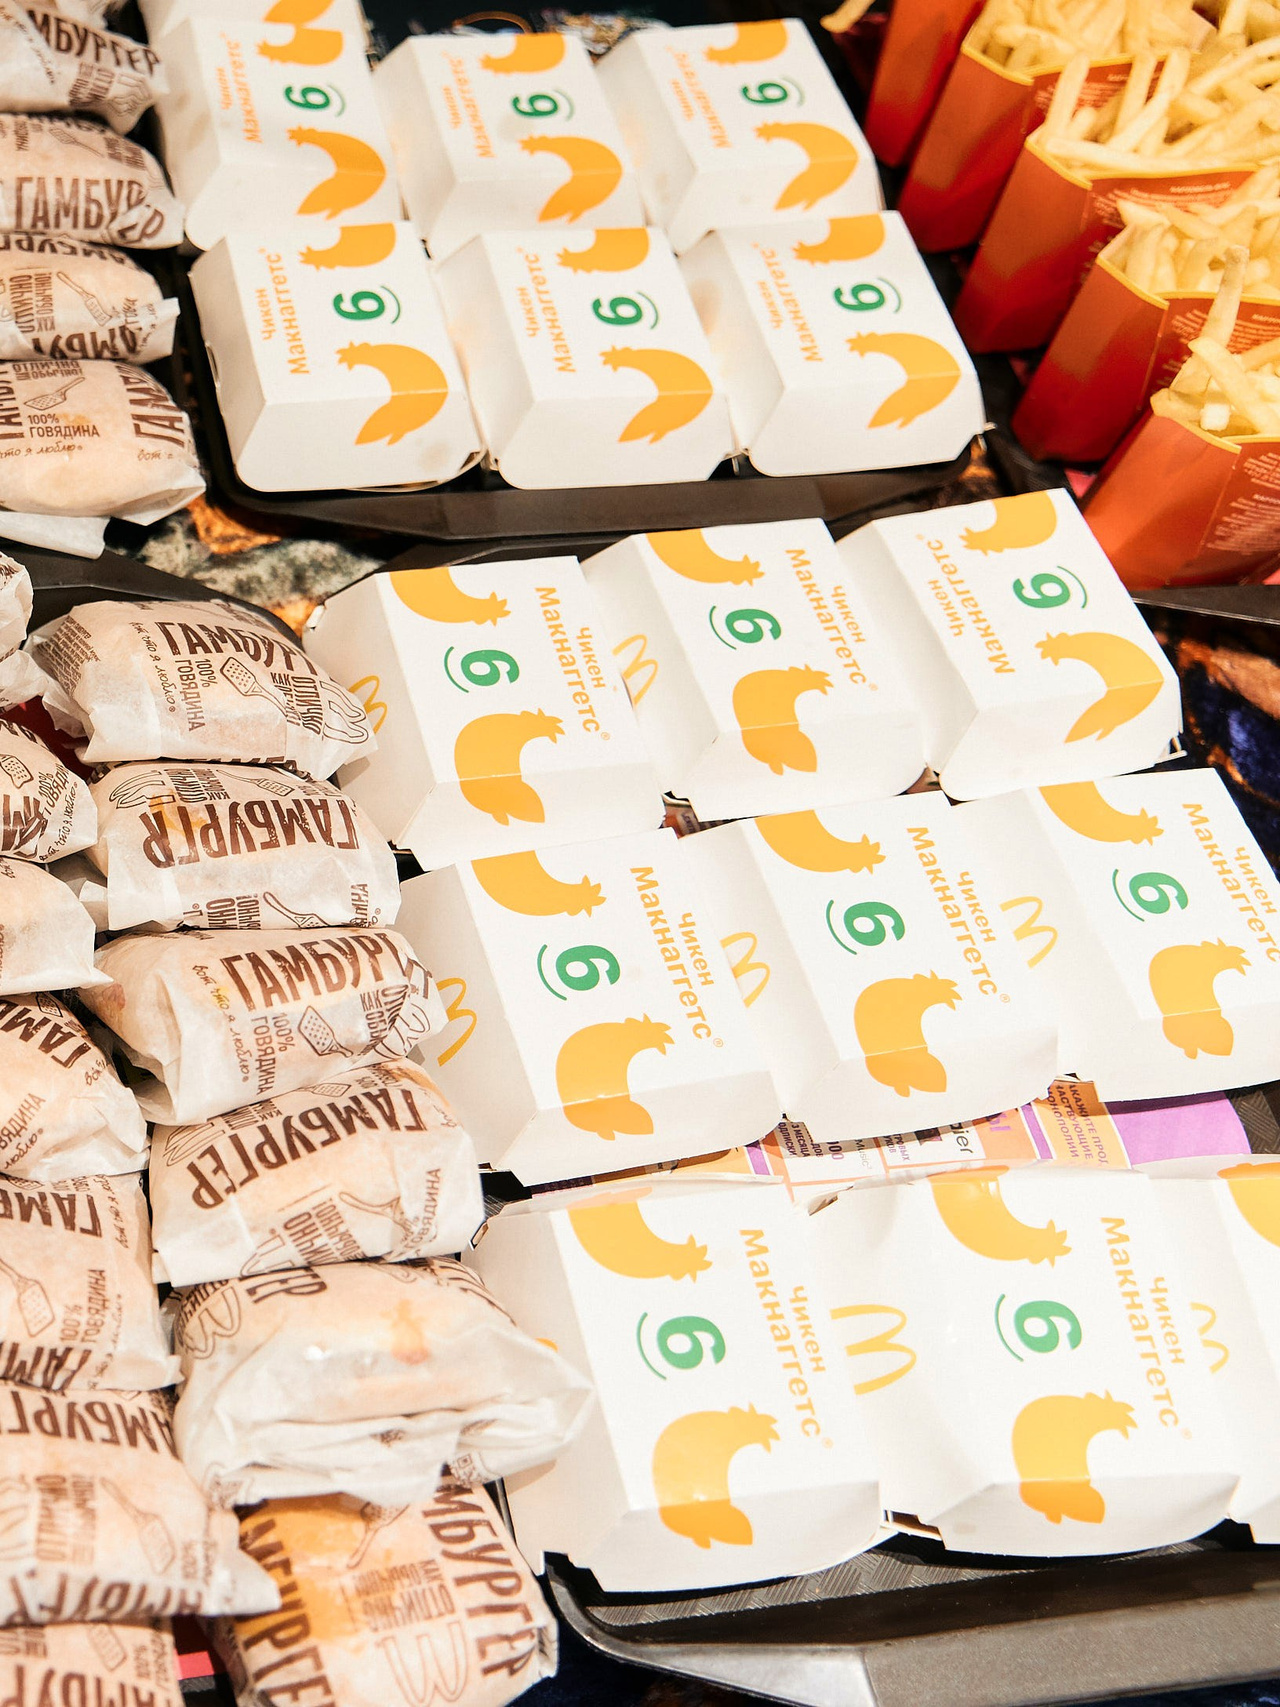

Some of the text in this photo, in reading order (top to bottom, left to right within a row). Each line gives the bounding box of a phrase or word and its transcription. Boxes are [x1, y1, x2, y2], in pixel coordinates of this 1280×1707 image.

[284, 85, 331, 110] 6
[511, 93, 559, 118] 6
[741, 82, 789, 105] 6
[255, 288, 272, 341] Чикен
[333, 290, 386, 321] 6
[519, 286, 539, 338] Чикен
[591, 295, 644, 327] 6
[757, 280, 782, 331] Чикен
[834, 283, 886, 313] 6
[27, 414, 60, 425] 100%
[29, 423, 101, 439] ГОВЯДИНА
[830, 584, 867, 644] Чикен
[927, 578, 963, 638] Чикен
[1012, 572, 1071, 609] 6
[725, 608, 782, 644] 6
[195, 658, 218, 688] 100%
[271, 672, 291, 685] КАК
[460, 648, 520, 687] 6
[575, 625, 607, 690] Чикен
[175, 659, 206, 732] ГОВЯДИНА
[1128, 872, 1189, 915] 6
[1233, 846, 1277, 915] Чикен
[843, 901, 906, 947] 6
[956, 870, 997, 943] Чикен
[555, 944, 621, 992] 6
[677, 911, 715, 987] Чикен
[360, 991, 381, 1011] КАК
[252, 1015, 277, 1095] ГОВЯДИНА
[273, 1012, 297, 1053] 100%
[186, 1085, 428, 1210] ГАМБУРГЕР
[59, 1304, 83, 1344] 100%
[81, 1268, 107, 1344] ГОВЯДИНА
[787, 1284, 827, 1374] Чикен
[1013, 1299, 1083, 1354] 6
[1149, 1275, 1186, 1365] Чикен
[656, 1315, 727, 1370] 6
